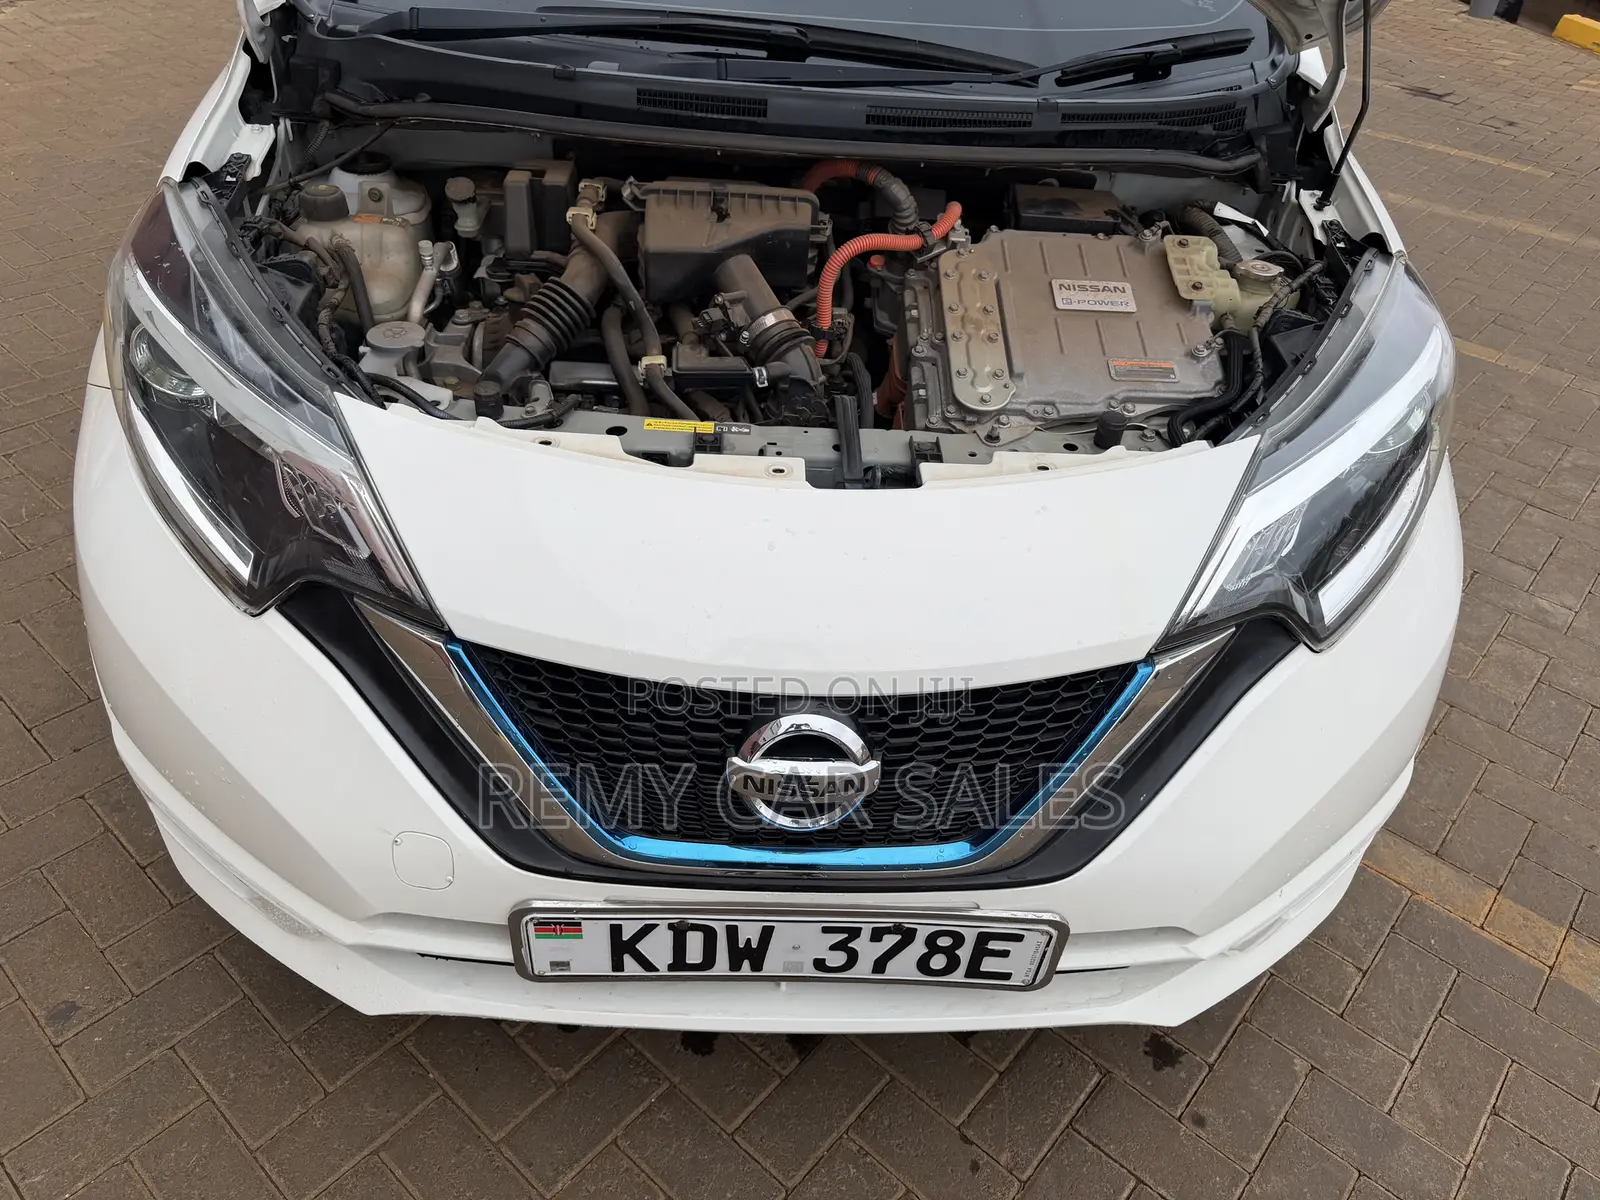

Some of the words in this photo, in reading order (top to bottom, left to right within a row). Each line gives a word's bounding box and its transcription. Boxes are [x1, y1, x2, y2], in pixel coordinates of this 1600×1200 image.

[1058, 283, 1127, 294] NISSAN
[742, 775, 866, 798] NISSAN
[609, 923, 776, 973] KDW
[812, 925, 1025, 981] 378E
